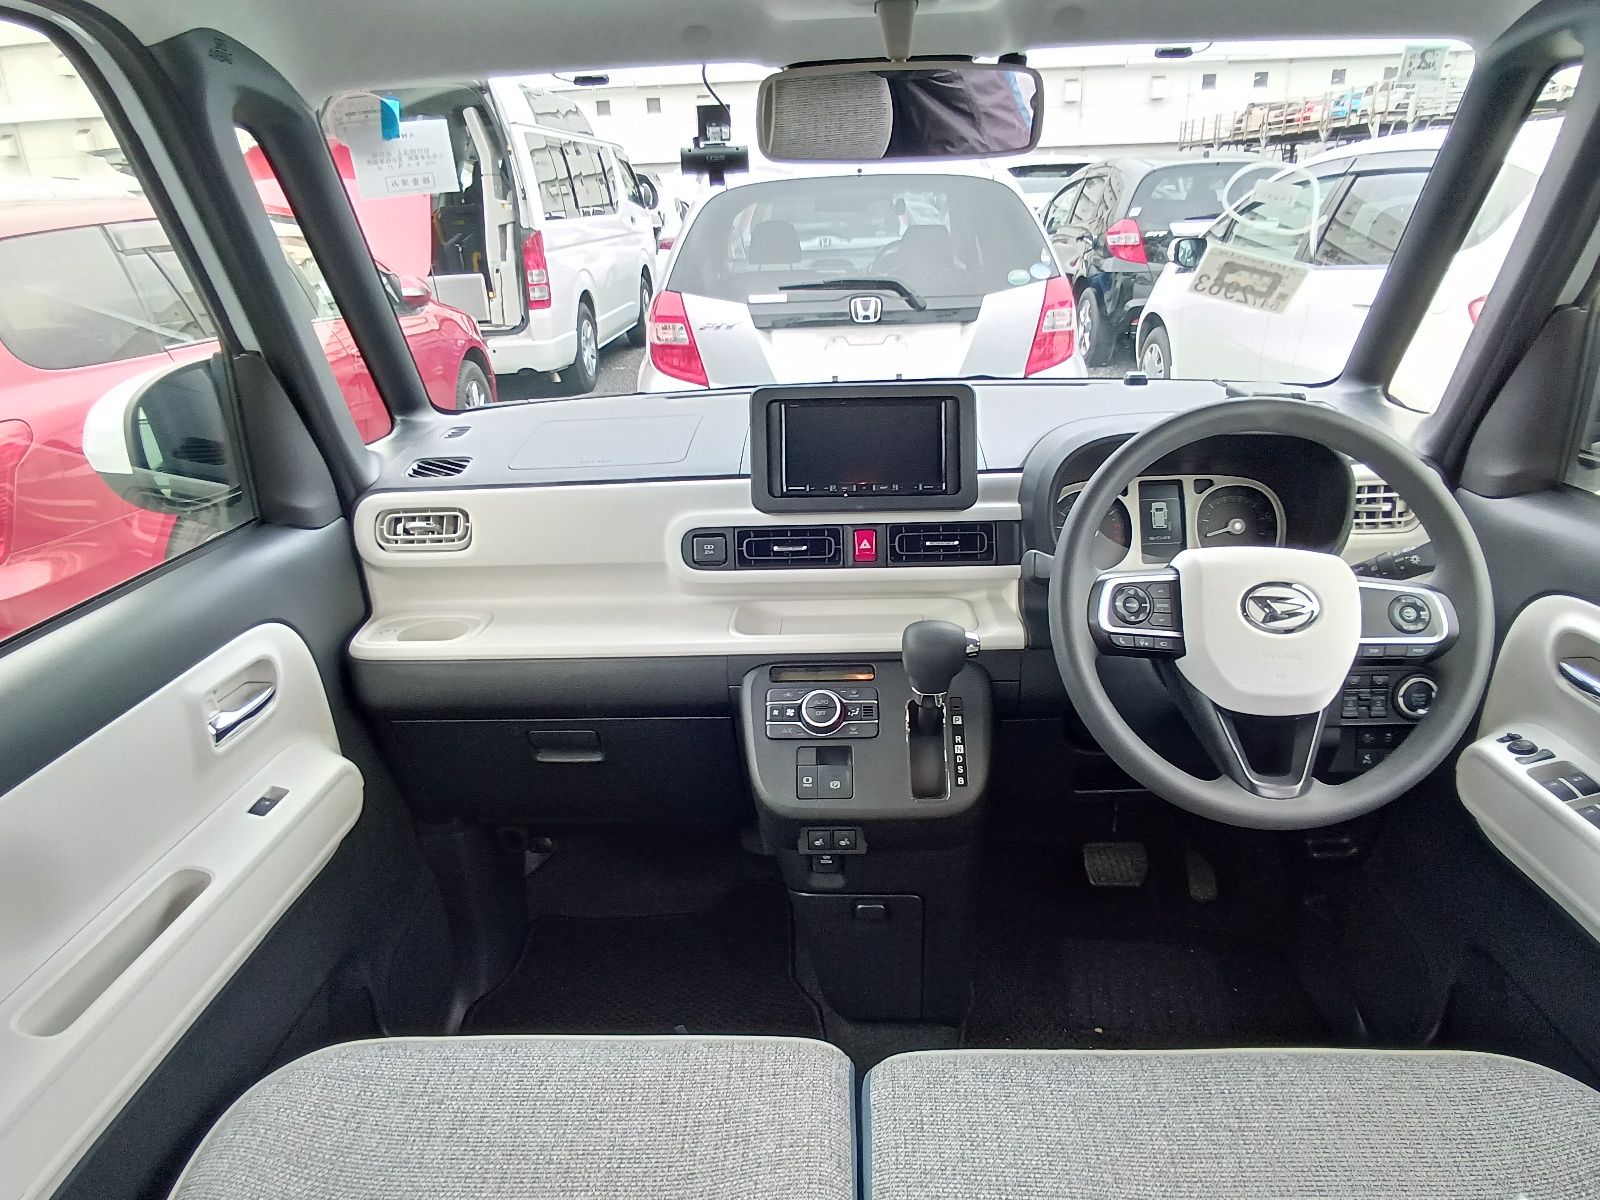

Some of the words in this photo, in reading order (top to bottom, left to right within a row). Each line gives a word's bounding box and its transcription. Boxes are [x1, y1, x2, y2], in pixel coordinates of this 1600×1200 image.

[954, 735, 962, 743] R
[956, 755, 963, 763] D
[957, 777, 964, 785] B
